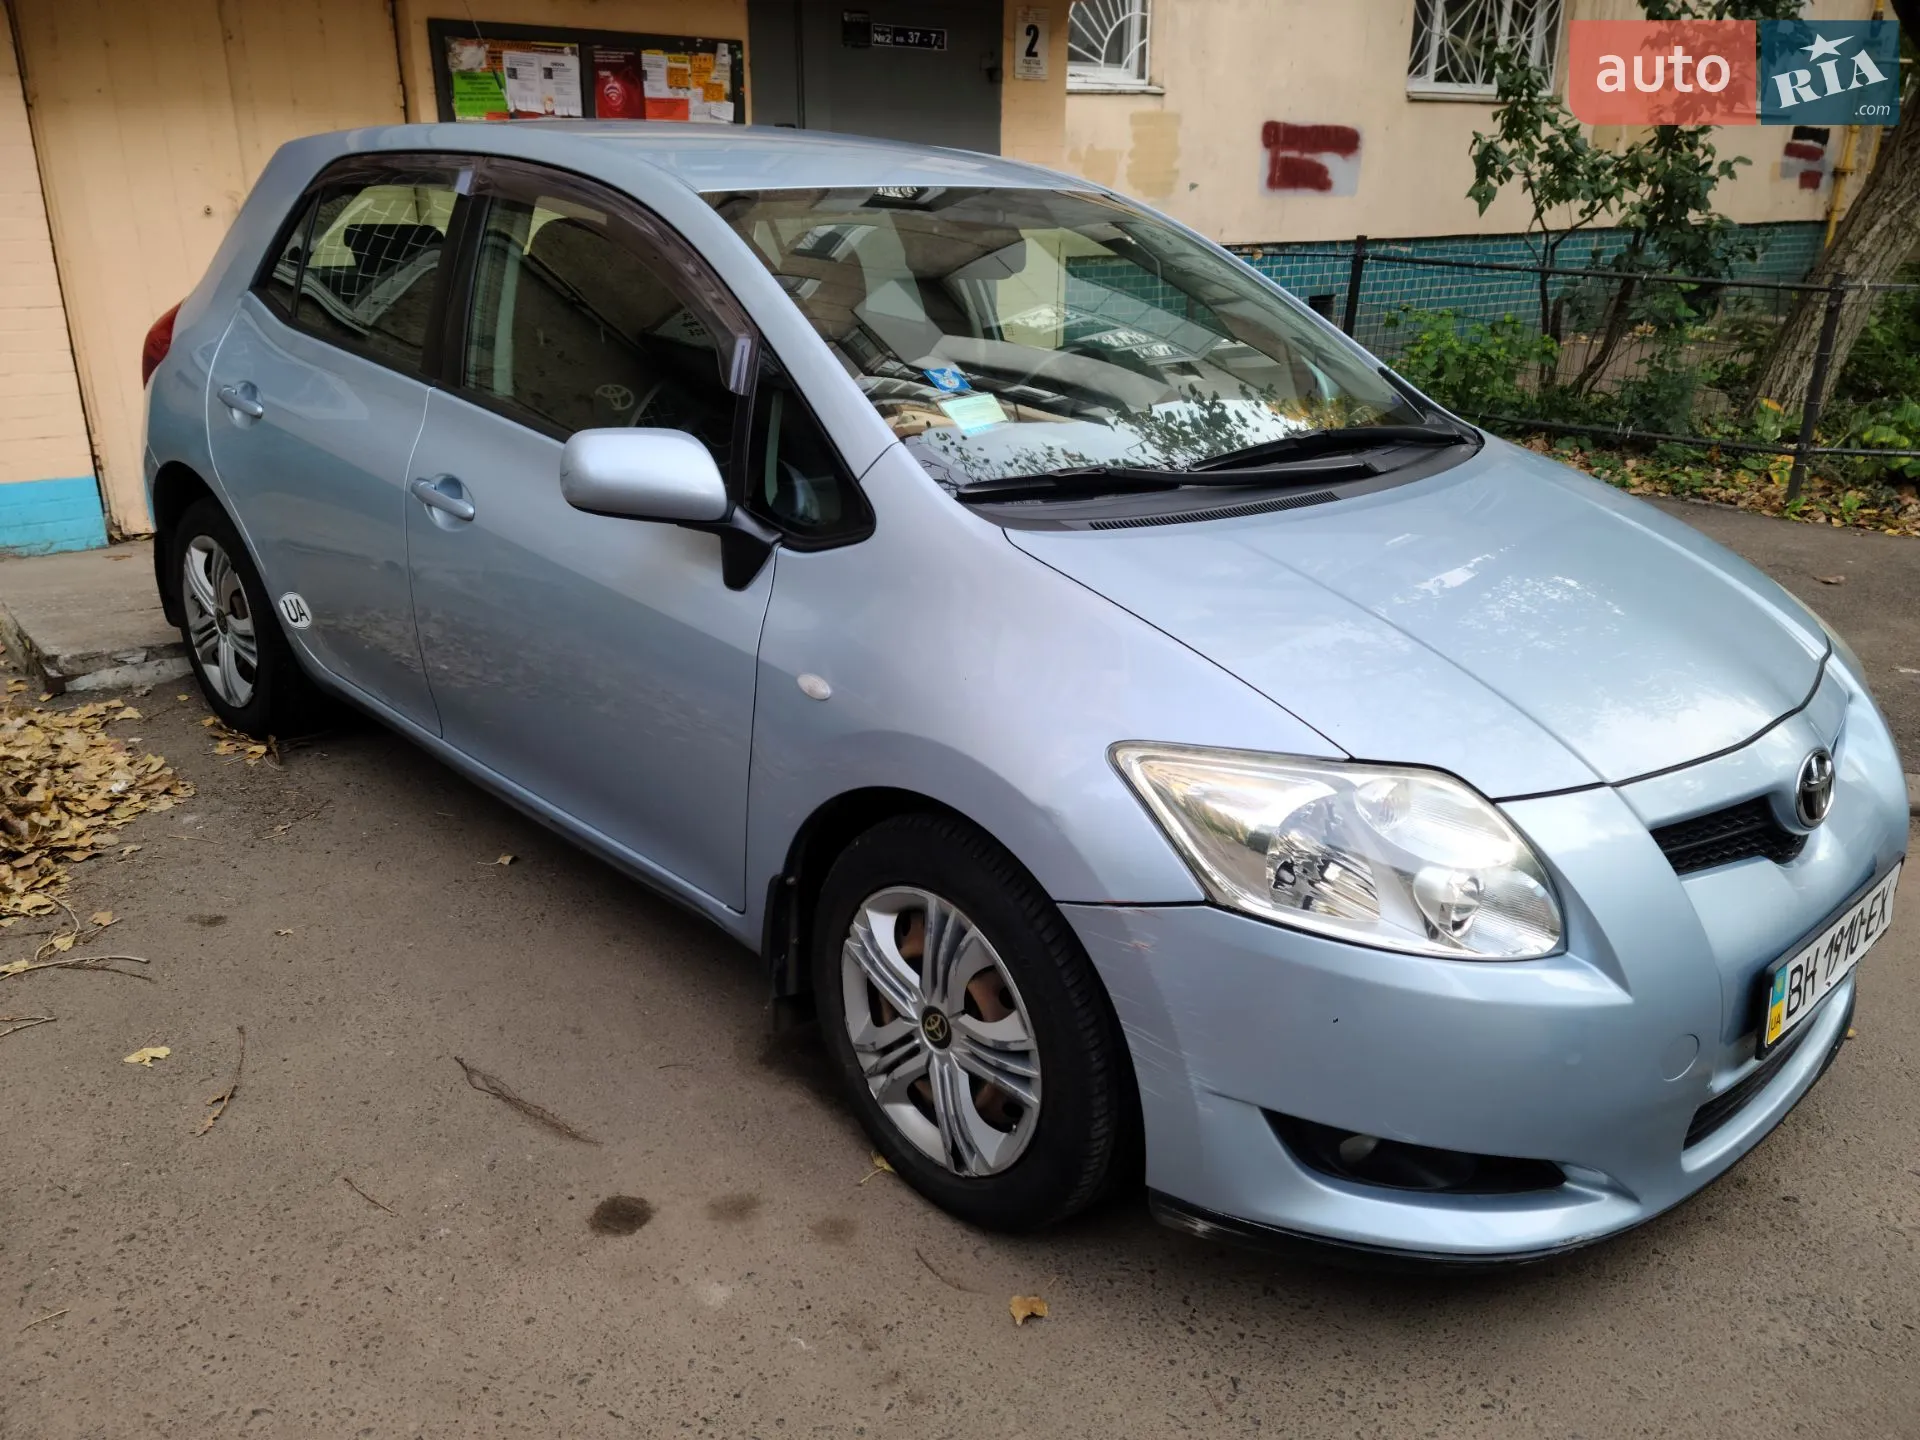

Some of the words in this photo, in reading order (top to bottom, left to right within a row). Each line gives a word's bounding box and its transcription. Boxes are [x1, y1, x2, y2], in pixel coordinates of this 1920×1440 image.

[908, 31, 921, 44] 37
[1025, 24, 1040, 57] 2
[282, 598, 310, 623] UA
[1786, 947, 1820, 1019] BH
[1824, 906, 1865, 980] 1910
[1863, 879, 1892, 944] EX
[1769, 1013, 1781, 1032] UA
